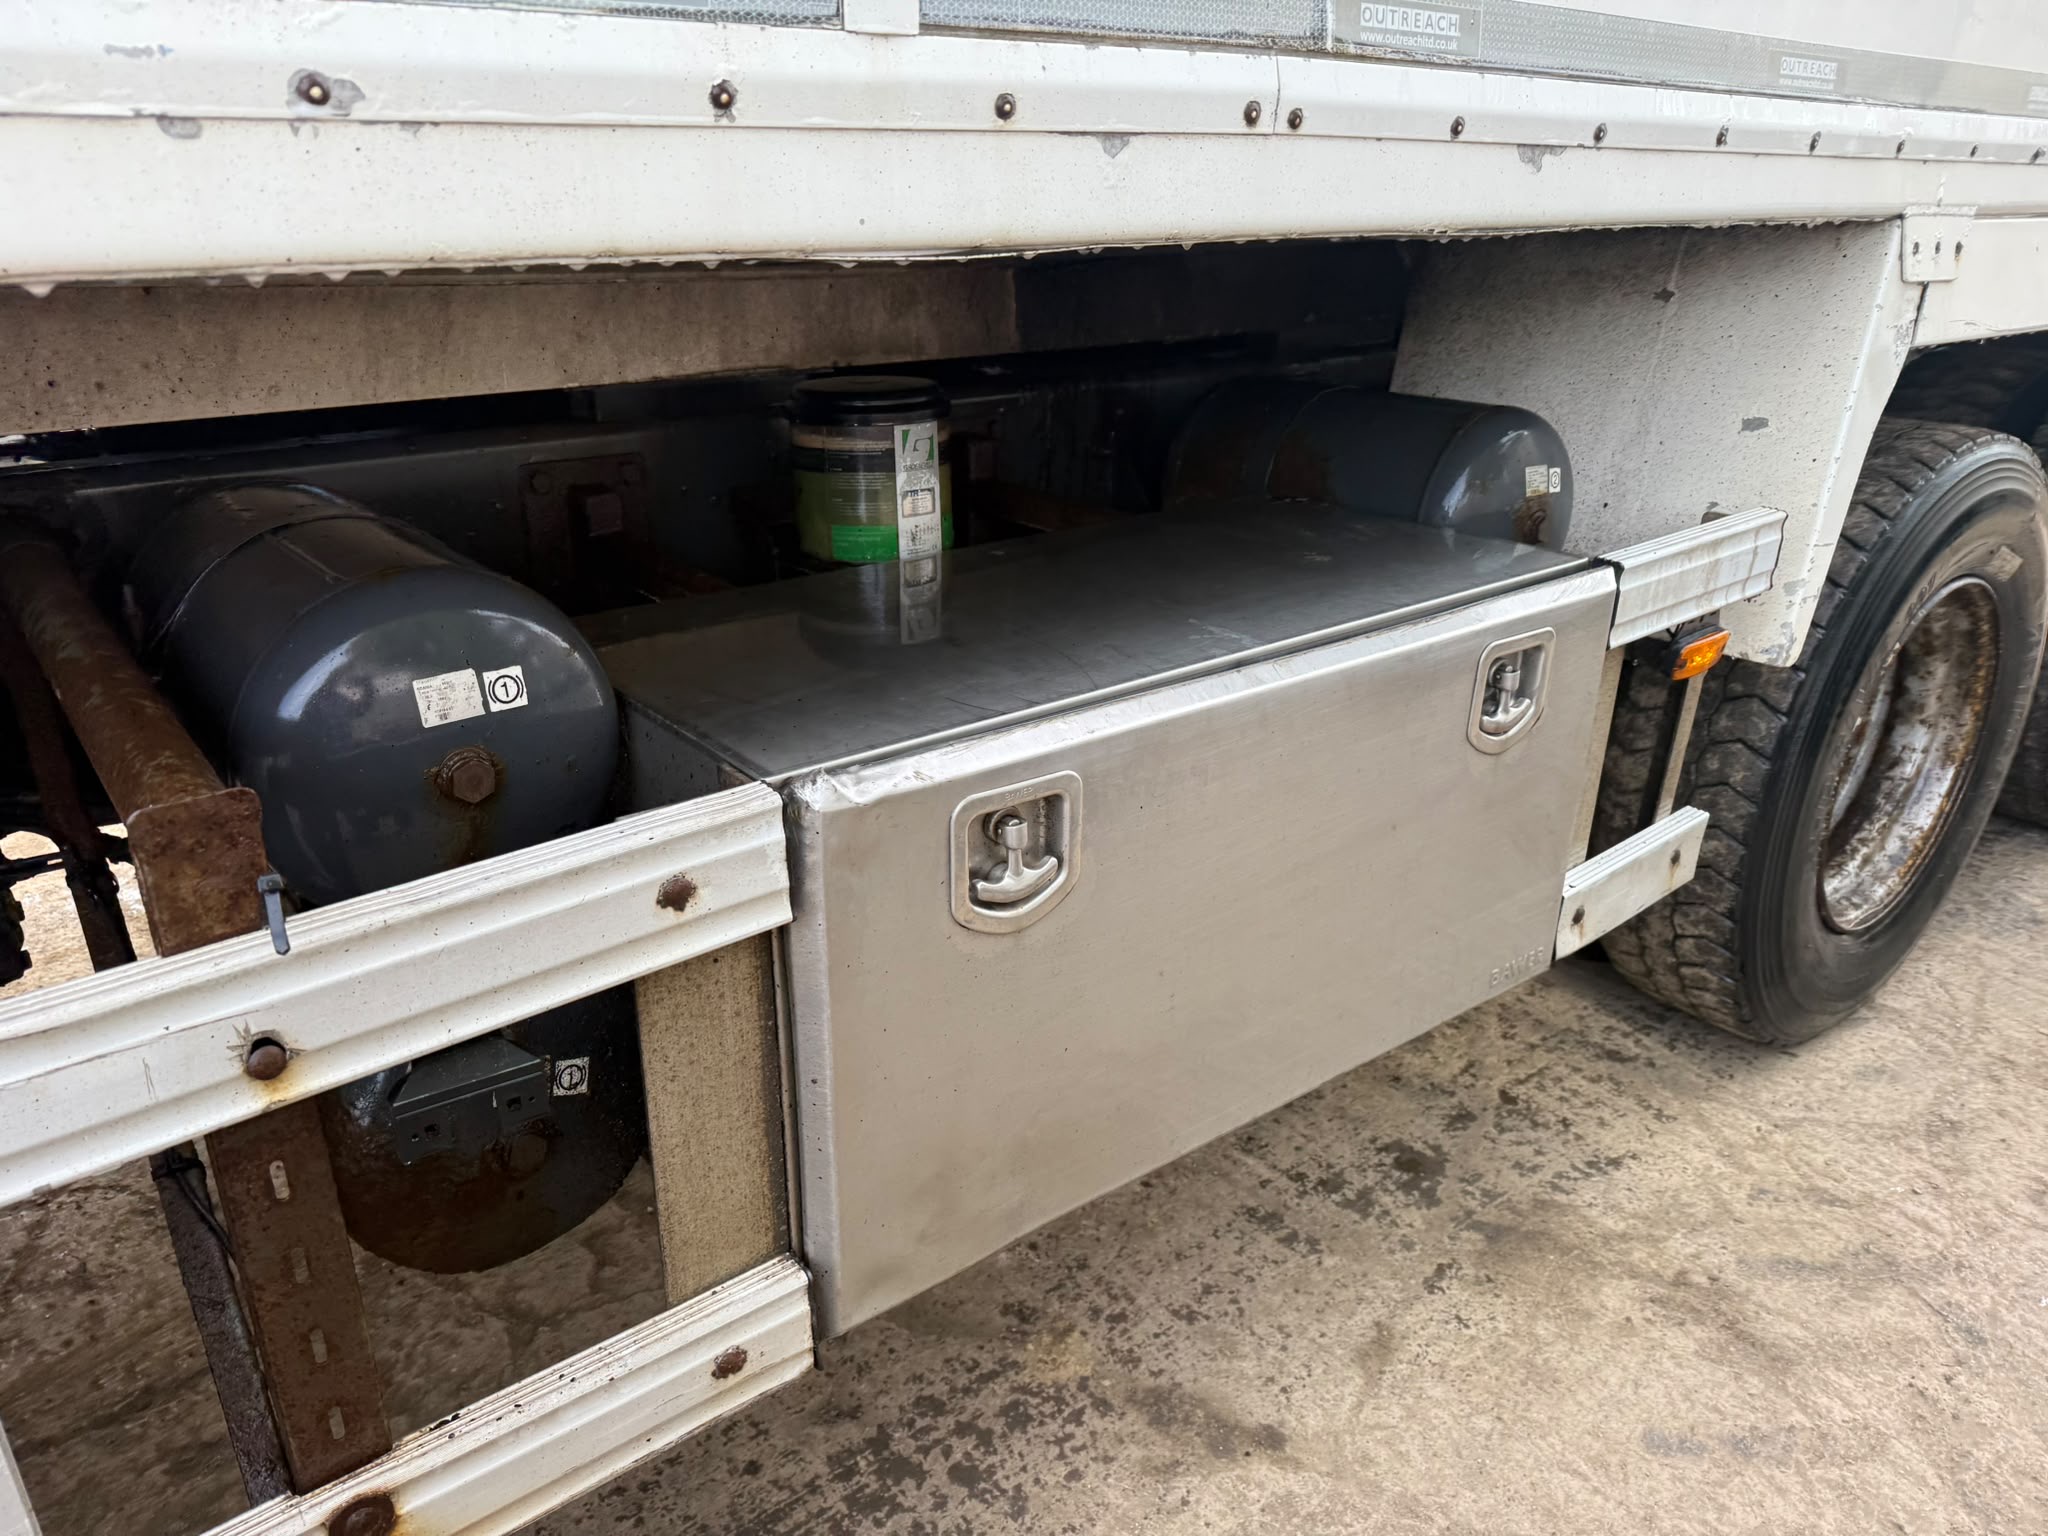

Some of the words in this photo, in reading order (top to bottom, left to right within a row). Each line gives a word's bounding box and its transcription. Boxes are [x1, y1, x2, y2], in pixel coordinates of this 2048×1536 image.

[1361, 6, 1459, 33] OUTREACH
[1360, 31, 1458, 50] www.outreachltd.co.uk
[1781, 58, 1837, 77] OUTREACH
